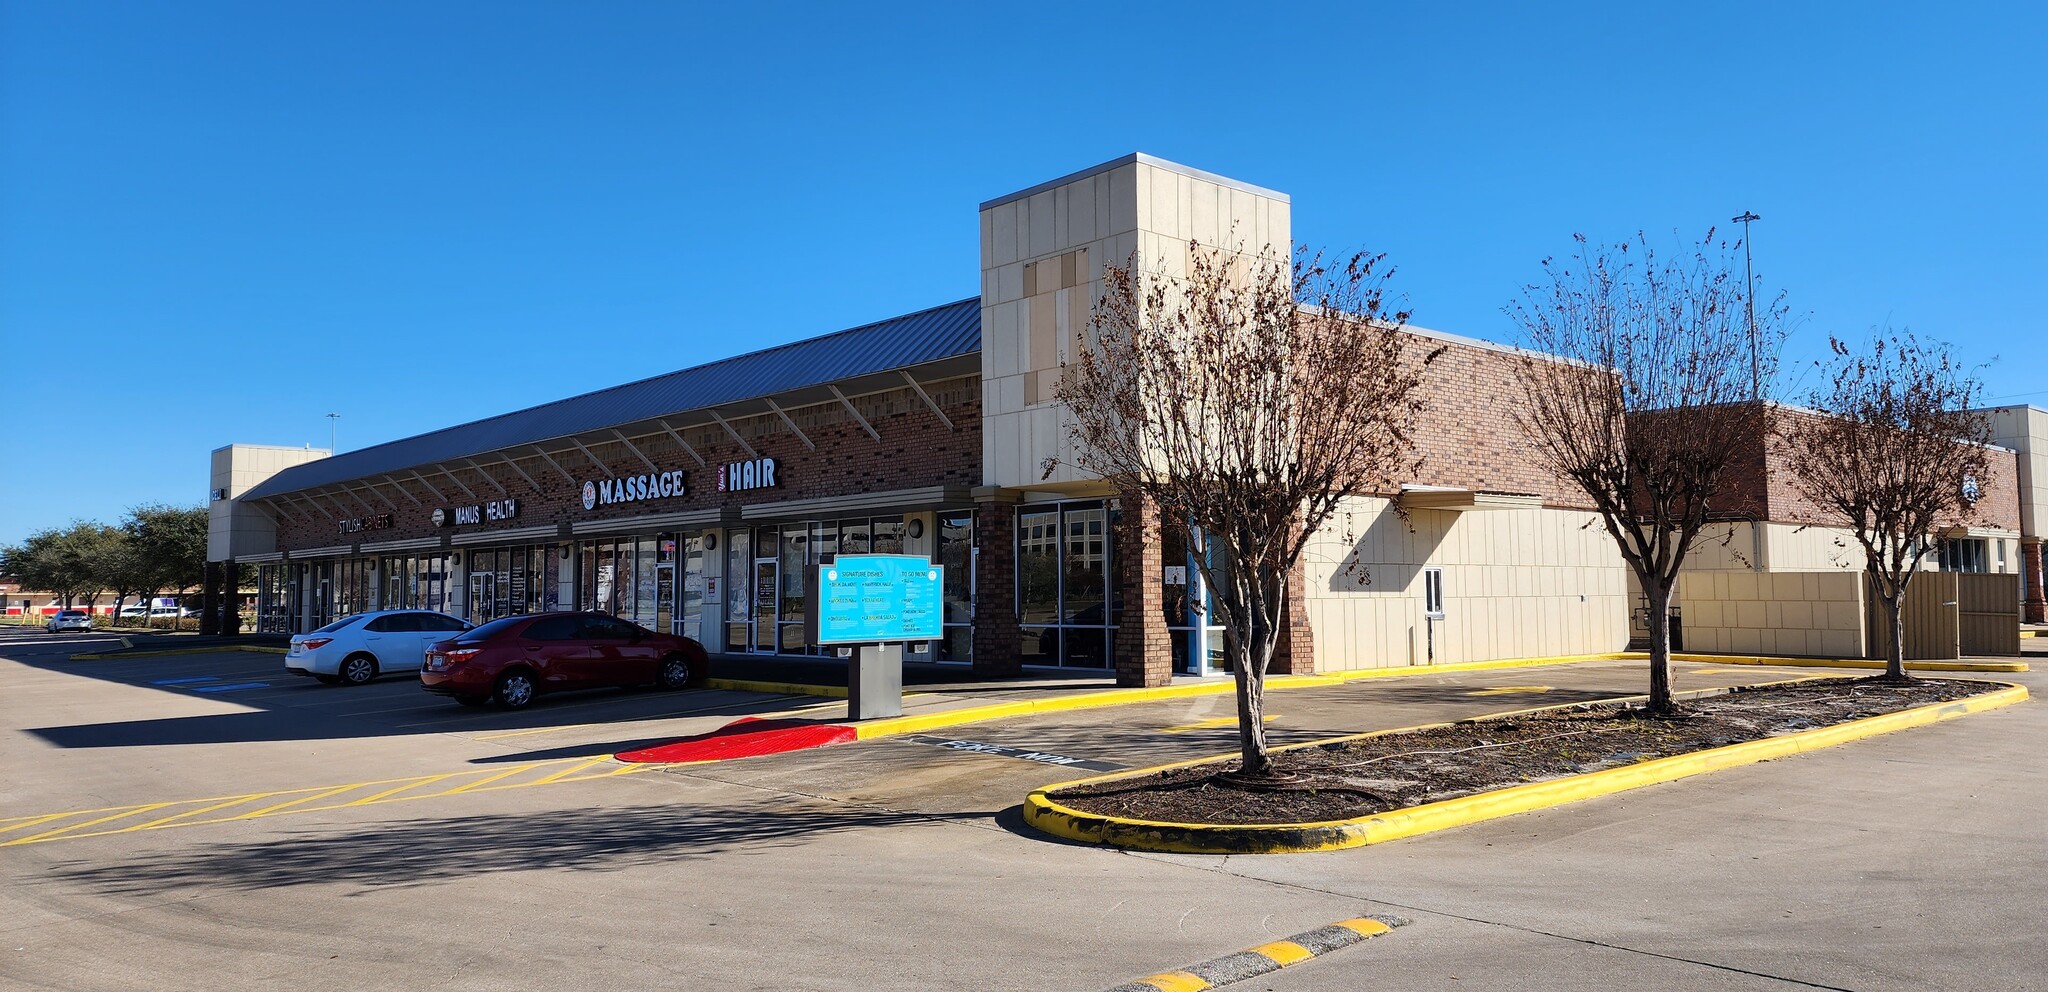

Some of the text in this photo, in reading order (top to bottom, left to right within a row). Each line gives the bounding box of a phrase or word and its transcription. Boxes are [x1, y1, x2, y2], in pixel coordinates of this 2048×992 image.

[599, 470, 684, 505] MASSAGE
[729, 458, 776, 492] HAIR
[338, 518, 361, 534] STYLISH
[455, 505, 480, 526] MANUS
[486, 499, 515, 521] HEALTH
